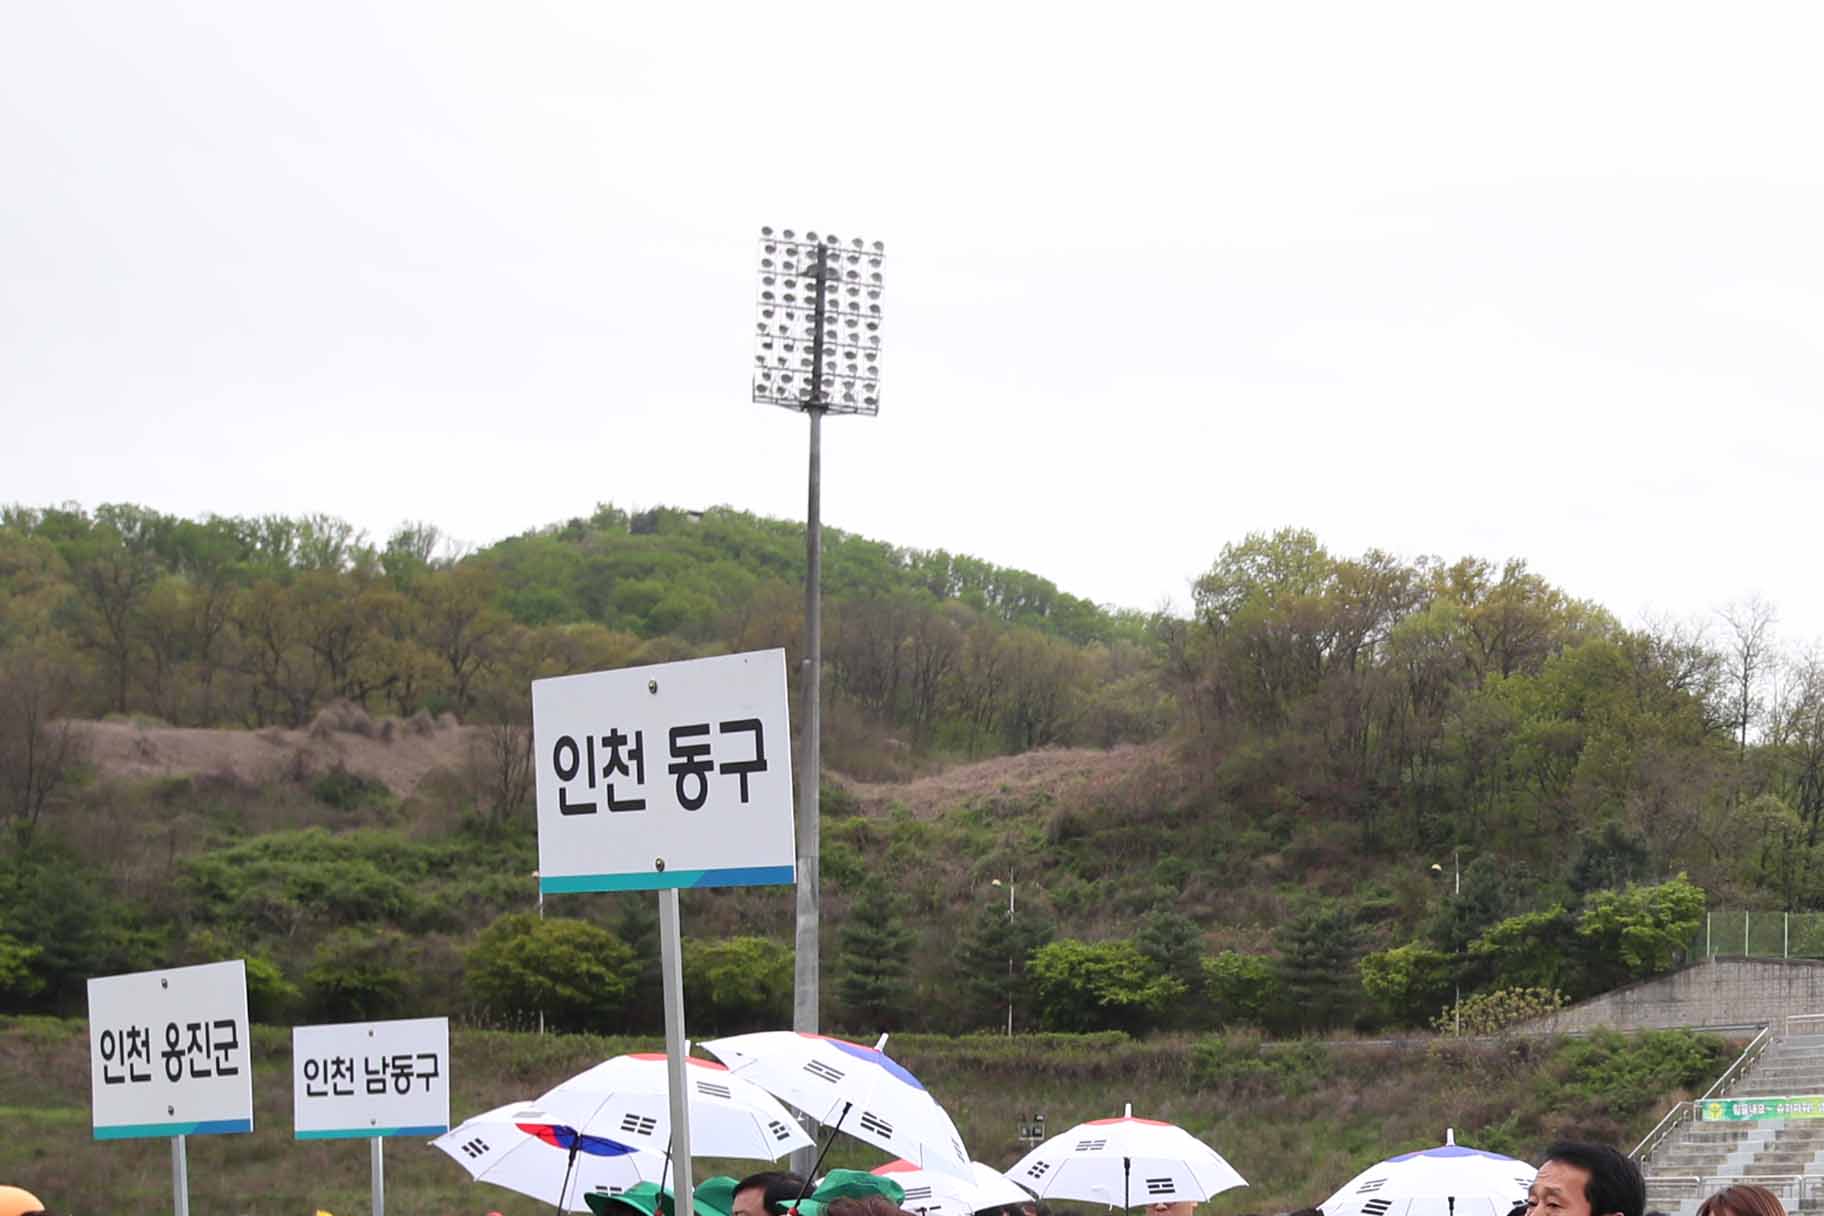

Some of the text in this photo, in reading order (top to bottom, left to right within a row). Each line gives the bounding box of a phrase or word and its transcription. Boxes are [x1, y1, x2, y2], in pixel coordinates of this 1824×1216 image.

[552, 717, 768, 817] 인천 동구
[100, 1018, 239, 1085] 인천 옹진군
[303, 1052, 439, 1098] 인천 남동구
